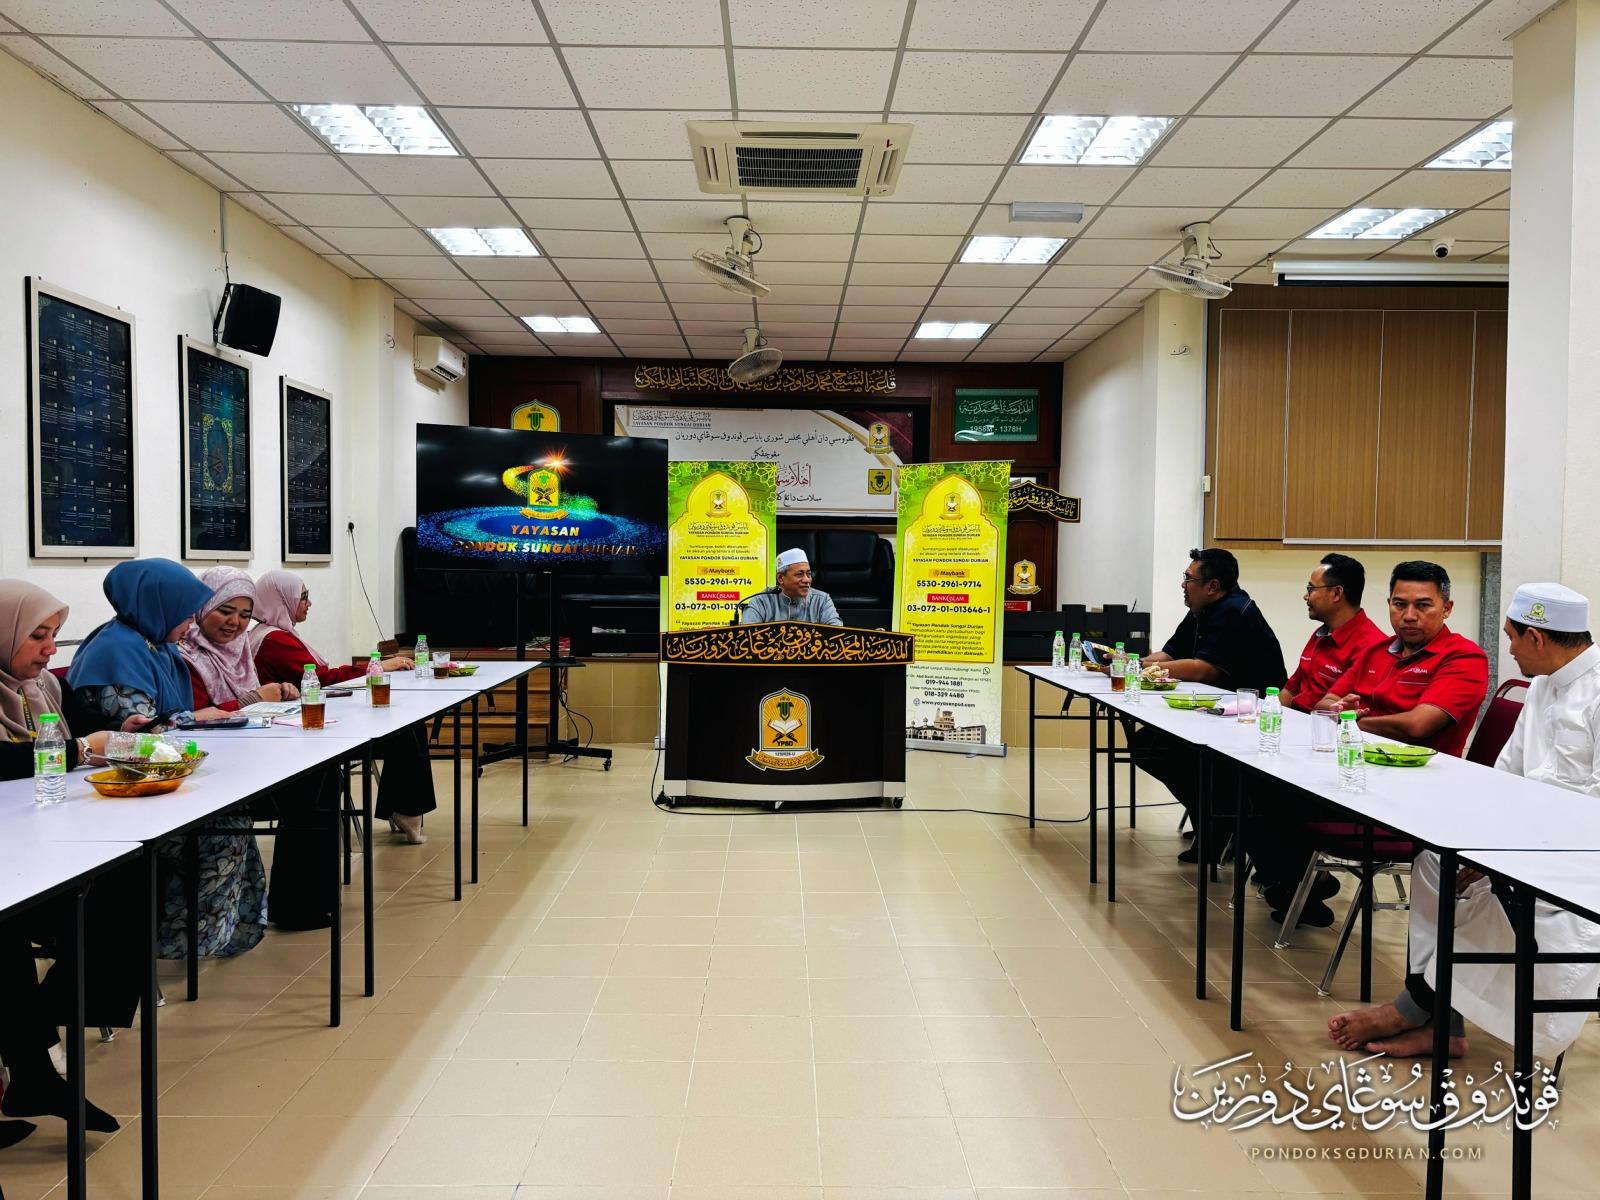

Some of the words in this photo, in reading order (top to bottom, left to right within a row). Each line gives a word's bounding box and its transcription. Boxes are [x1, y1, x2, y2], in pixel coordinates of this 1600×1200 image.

[511, 525, 580, 536] YAYASAN
[454, 540, 518, 553] PONDOK
[522, 541, 578, 554] SUNGAI
[907, 604, 990, 613] 03-072-01-013646-1
